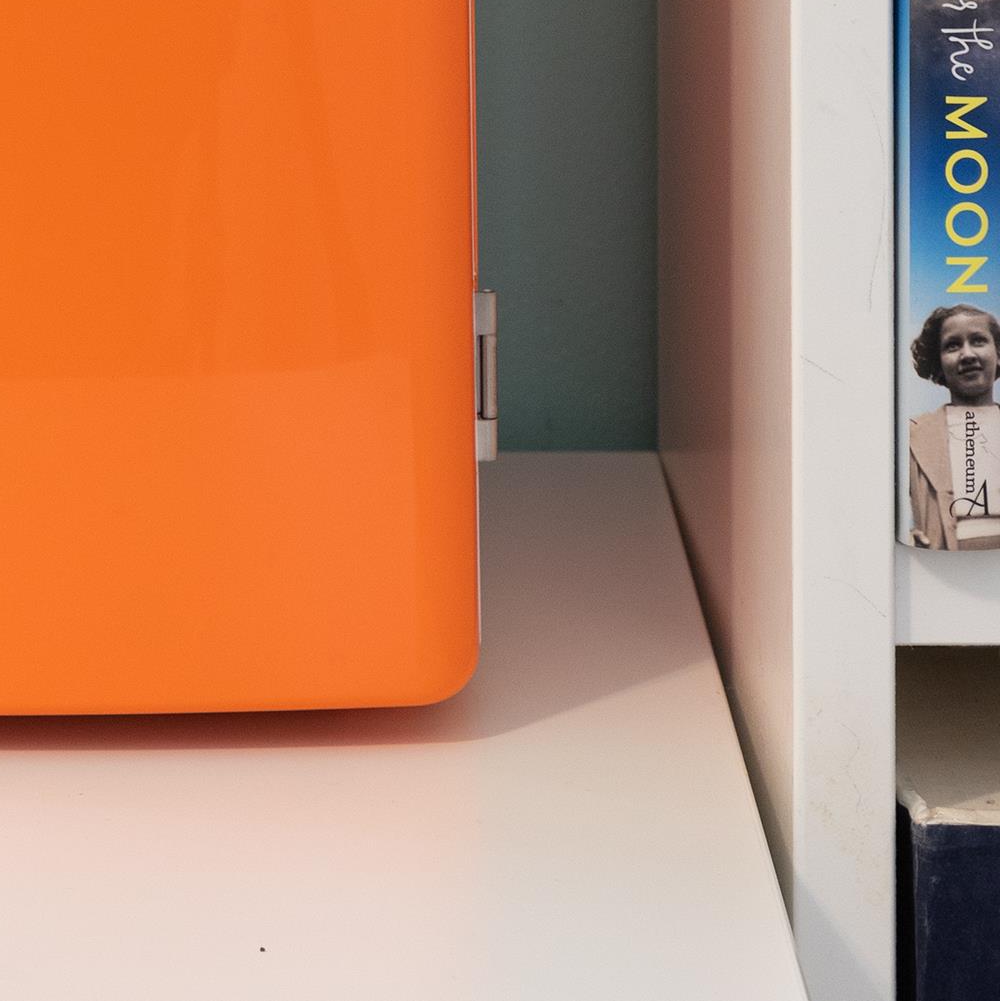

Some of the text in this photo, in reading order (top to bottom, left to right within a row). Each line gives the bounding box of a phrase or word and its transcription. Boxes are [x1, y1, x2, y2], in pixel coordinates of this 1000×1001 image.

[941, 19, 994, 81] the
[945, 96, 989, 293] MOON
[965, 411, 980, 493] atheneum
